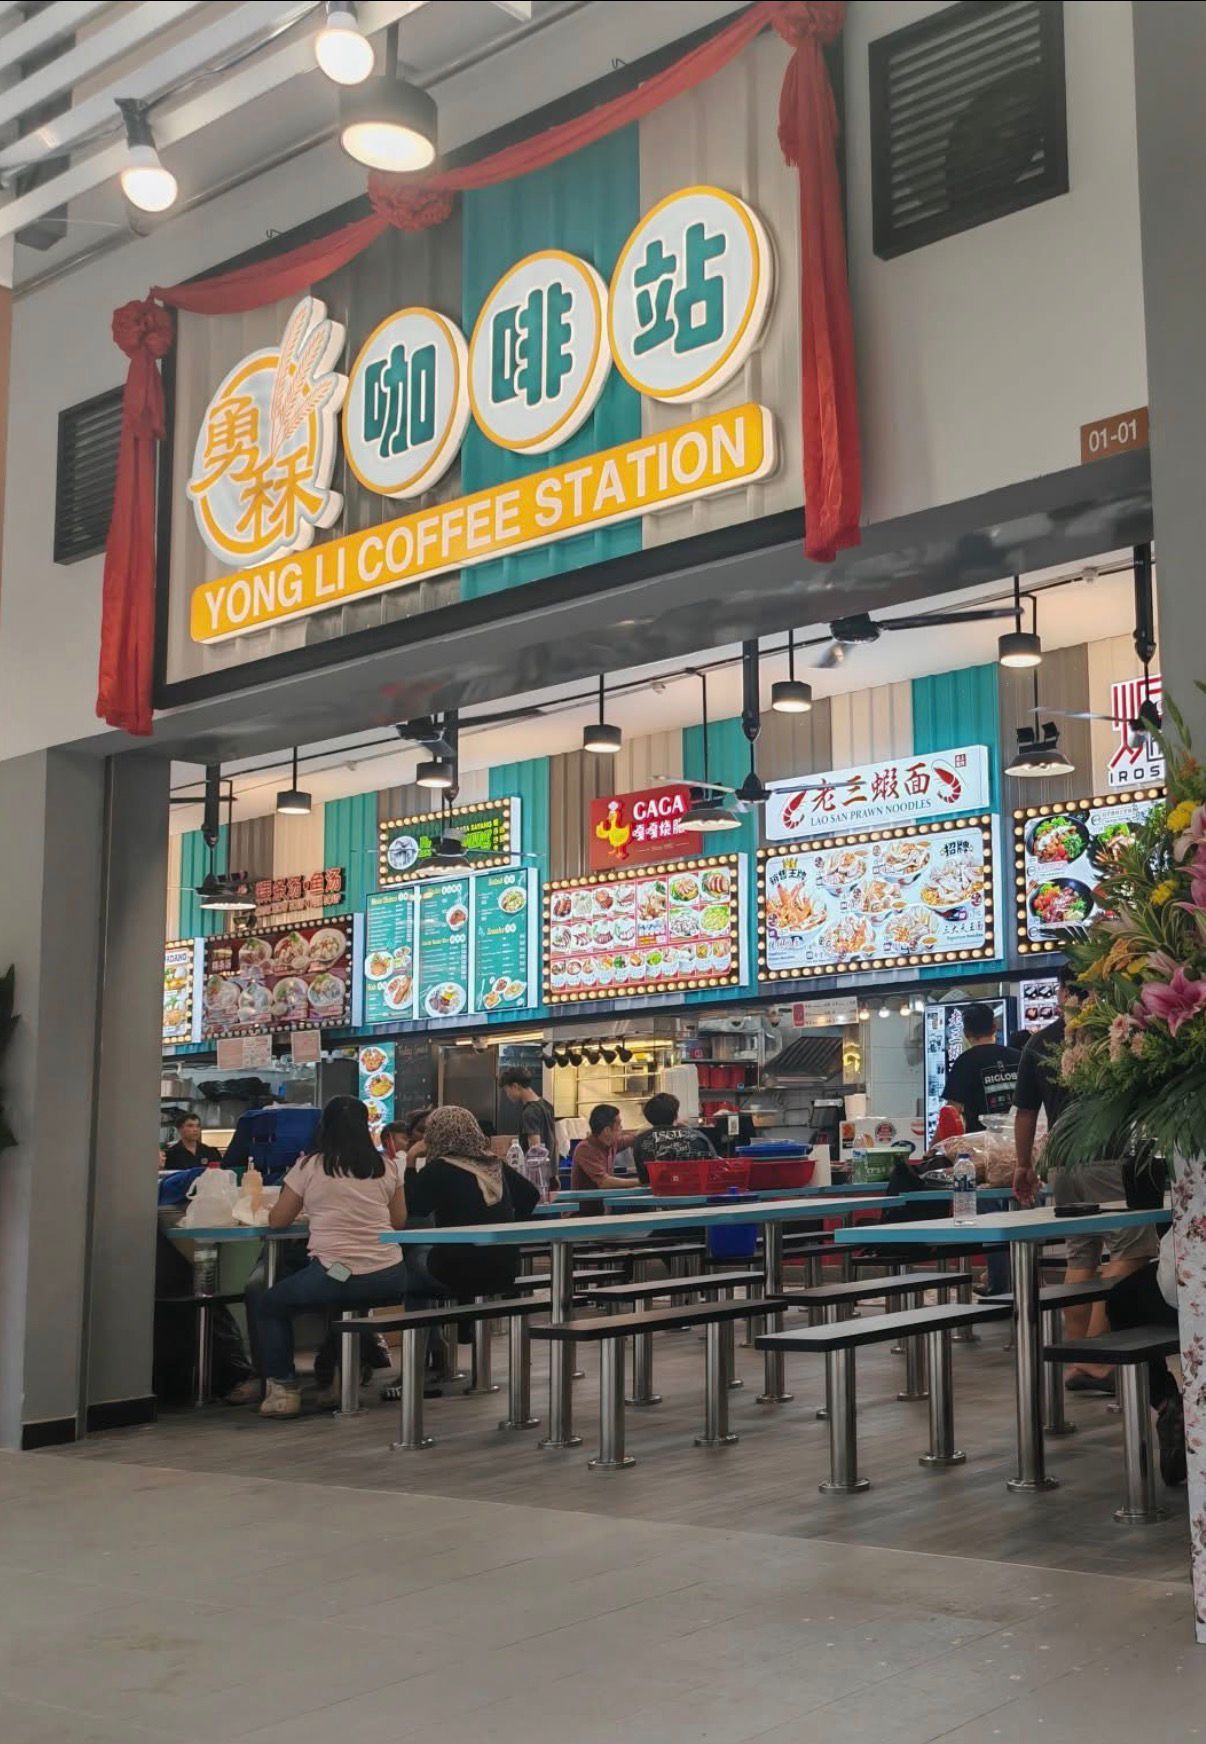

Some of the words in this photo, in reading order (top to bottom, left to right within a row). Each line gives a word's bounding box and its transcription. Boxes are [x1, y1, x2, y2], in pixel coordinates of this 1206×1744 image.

[363, 222, 727, 459] 咖啡站
[1089, 418, 1137, 452] 01-01
[204, 563, 303, 630] YONG
[314, 554, 346, 596] LI
[357, 496, 520, 581] COFFEE
[534, 417, 745, 527] STATION
[811, 762, 931, 813] 老三蝦面
[811, 815, 829, 827] LAO
[830, 811, 848, 824] SAN
[850, 806, 885, 821] PRAWN
[885, 799, 932, 814] NOODLES
